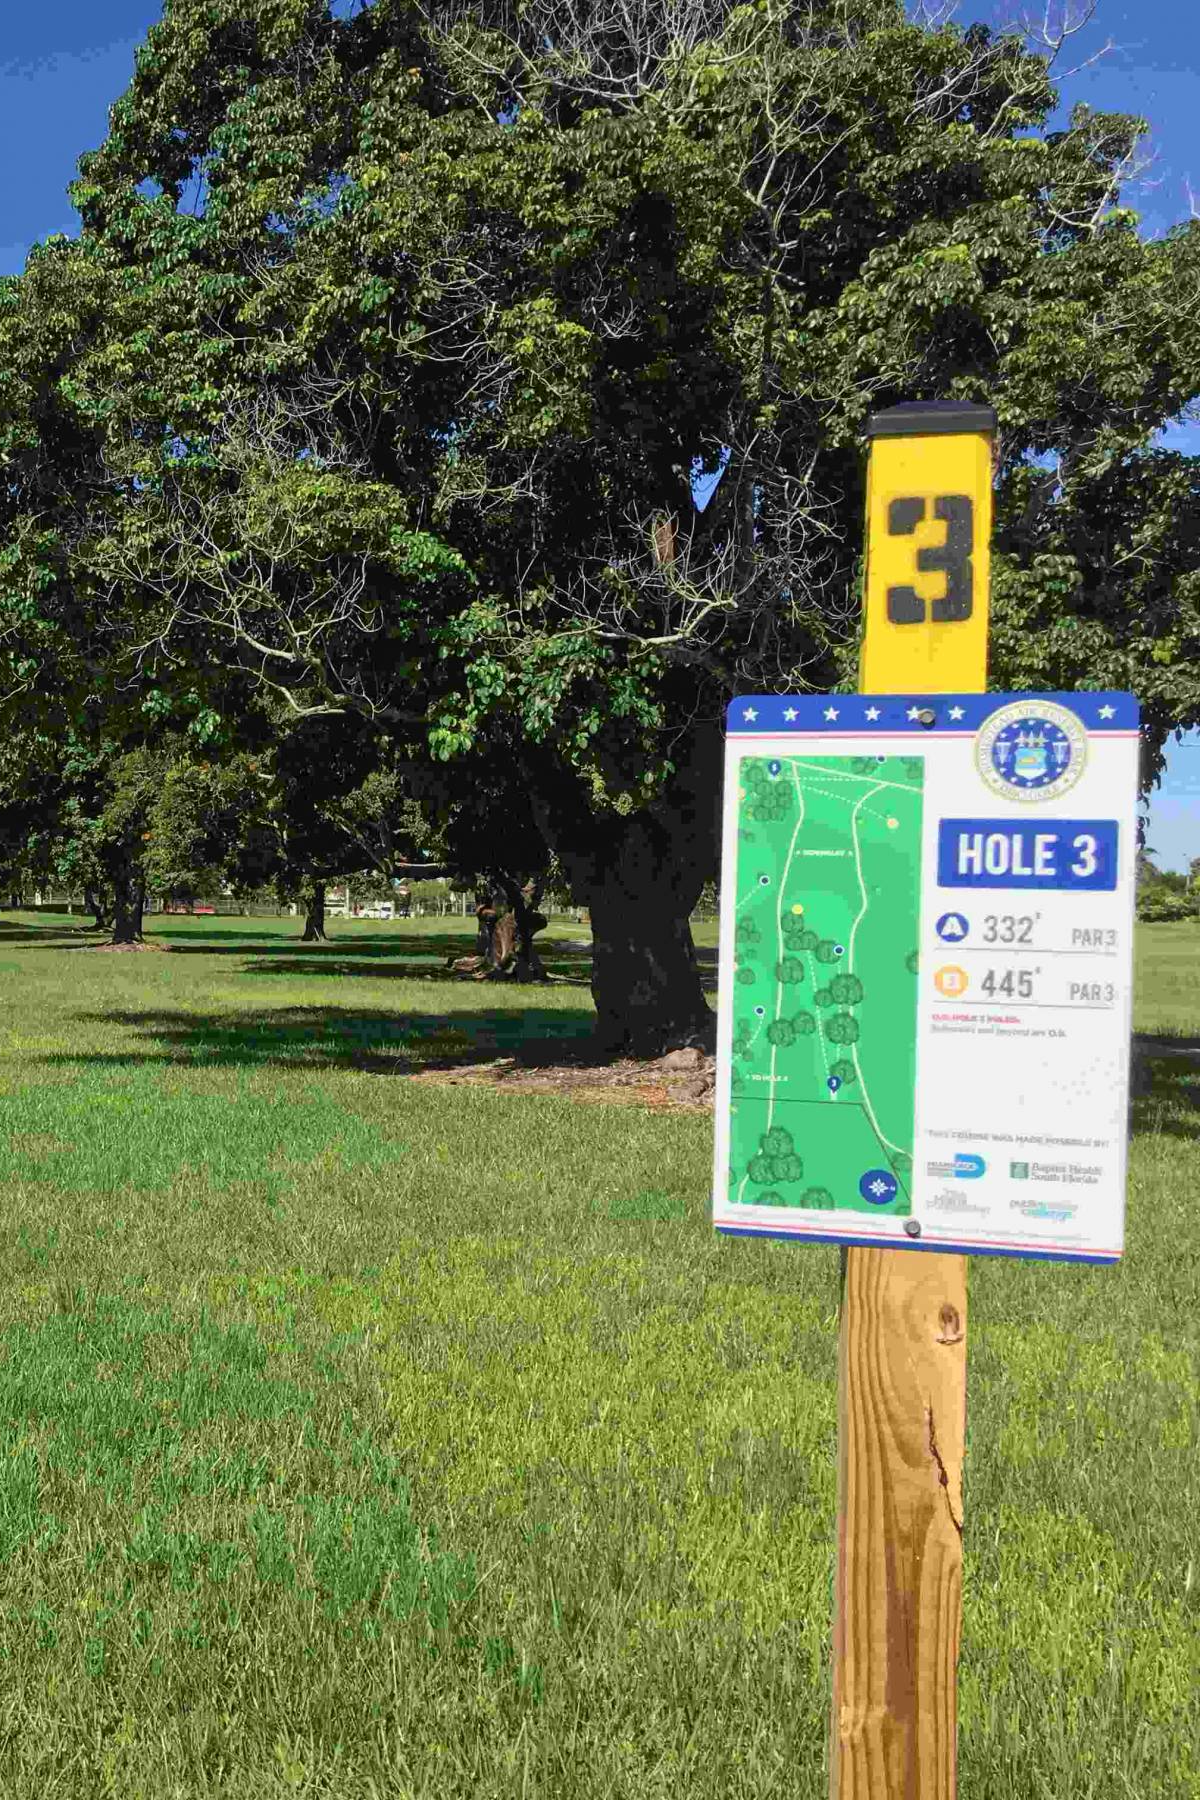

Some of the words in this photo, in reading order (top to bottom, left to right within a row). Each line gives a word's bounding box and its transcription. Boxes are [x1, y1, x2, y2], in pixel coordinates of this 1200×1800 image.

[886, 494, 974, 625] 3
[957, 833, 1058, 876] HOLE
[1071, 834, 1098, 877] 3
[1071, 928, 1103, 946] PAR
[1104, 929, 1117, 946] 3
[1069, 983, 1103, 1002] PAR
[1103, 984, 1115, 1002] 3
